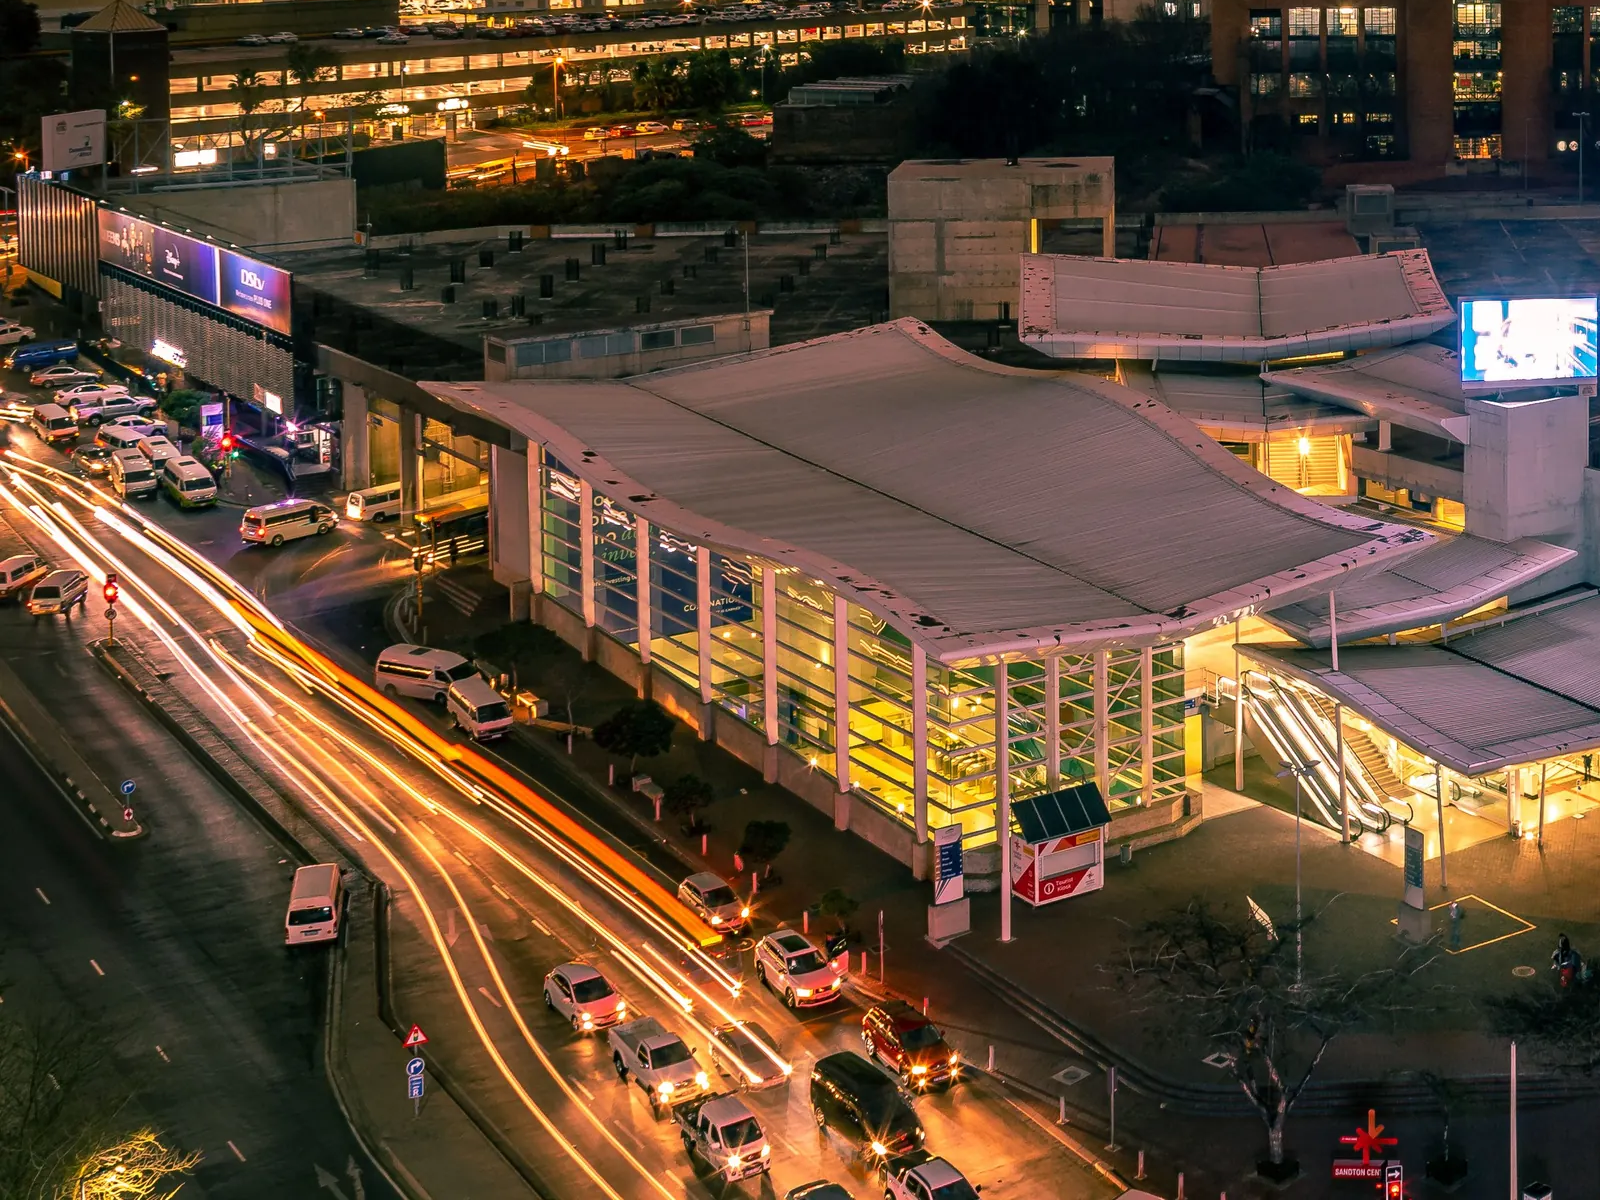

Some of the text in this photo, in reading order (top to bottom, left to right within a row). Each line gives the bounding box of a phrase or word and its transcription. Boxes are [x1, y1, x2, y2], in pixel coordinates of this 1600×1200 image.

[1056, 877, 1073, 886] Tourist
[412, 1088, 419, 1097] R
[1335, 1168, 1366, 1176] SANDTON
